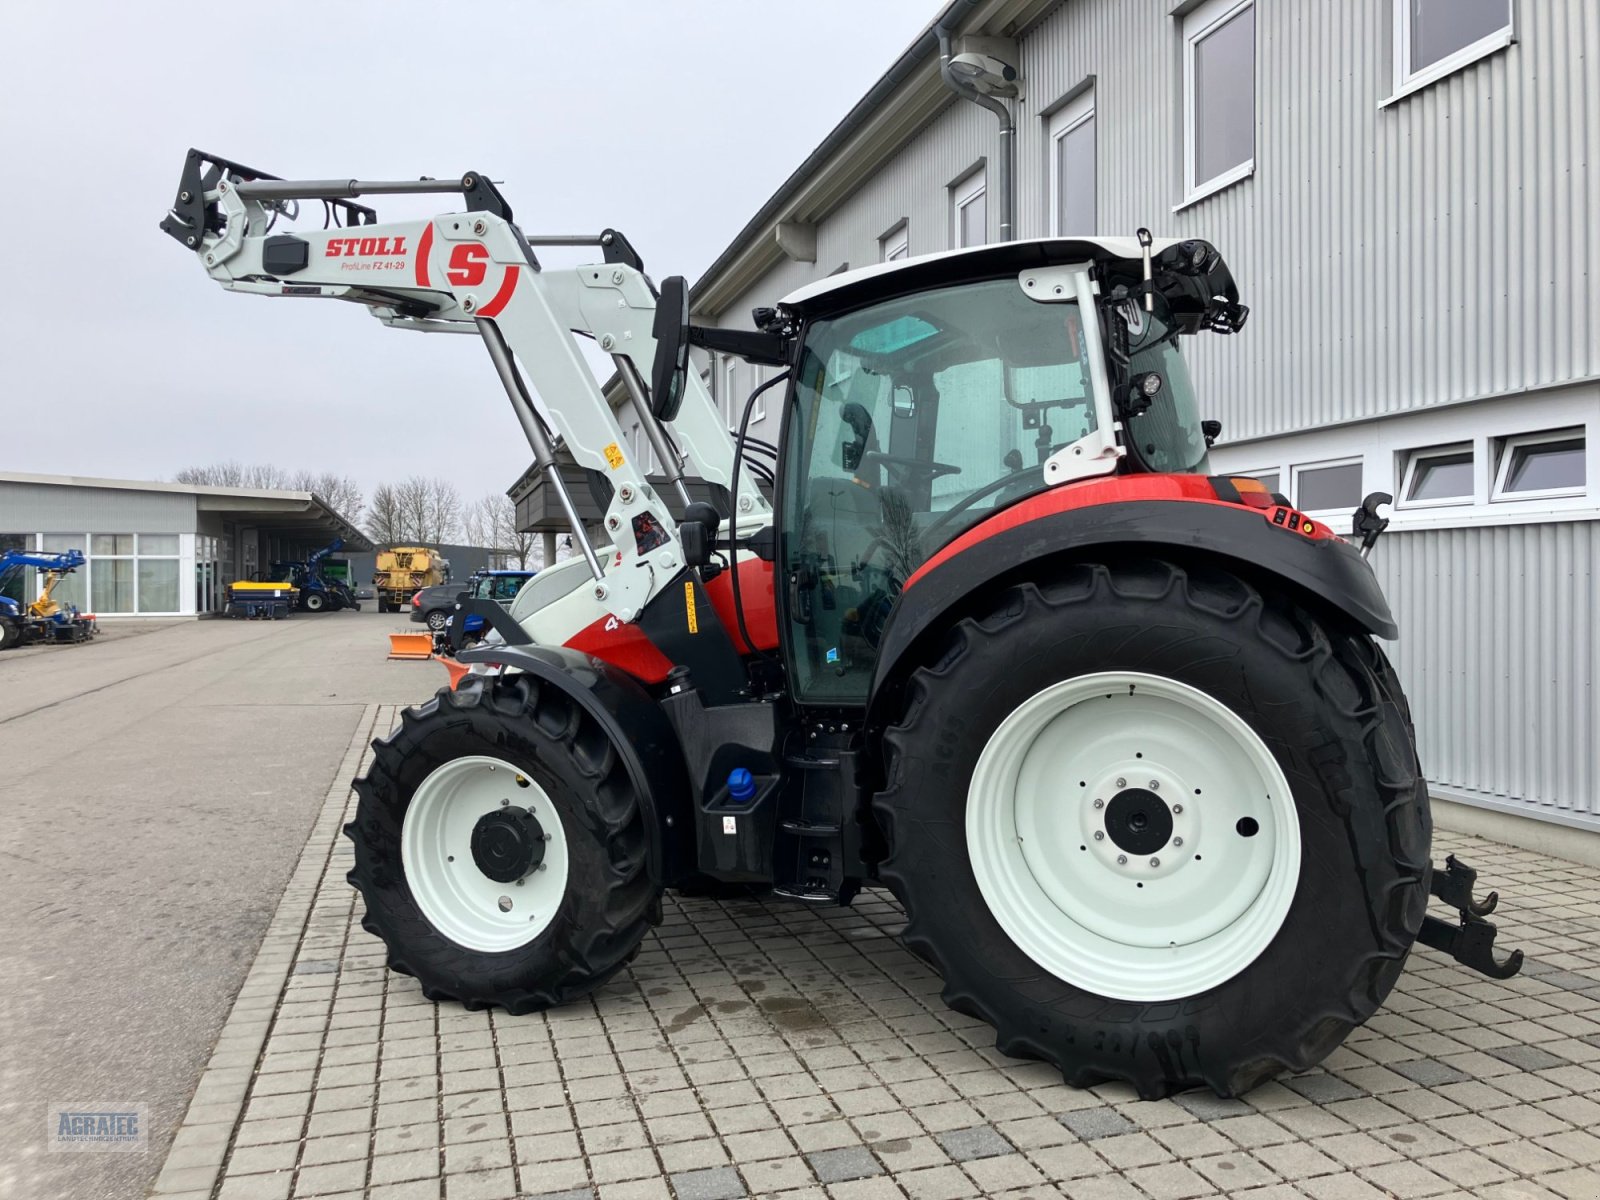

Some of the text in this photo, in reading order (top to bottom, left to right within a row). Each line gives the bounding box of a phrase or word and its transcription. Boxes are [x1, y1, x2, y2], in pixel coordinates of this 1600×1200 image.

[325, 236, 407, 257] STOLL
[341, 260, 405, 271] ProfiLine FZ 41-29
[446, 243, 490, 287] S
[605, 616, 619, 631] 4
